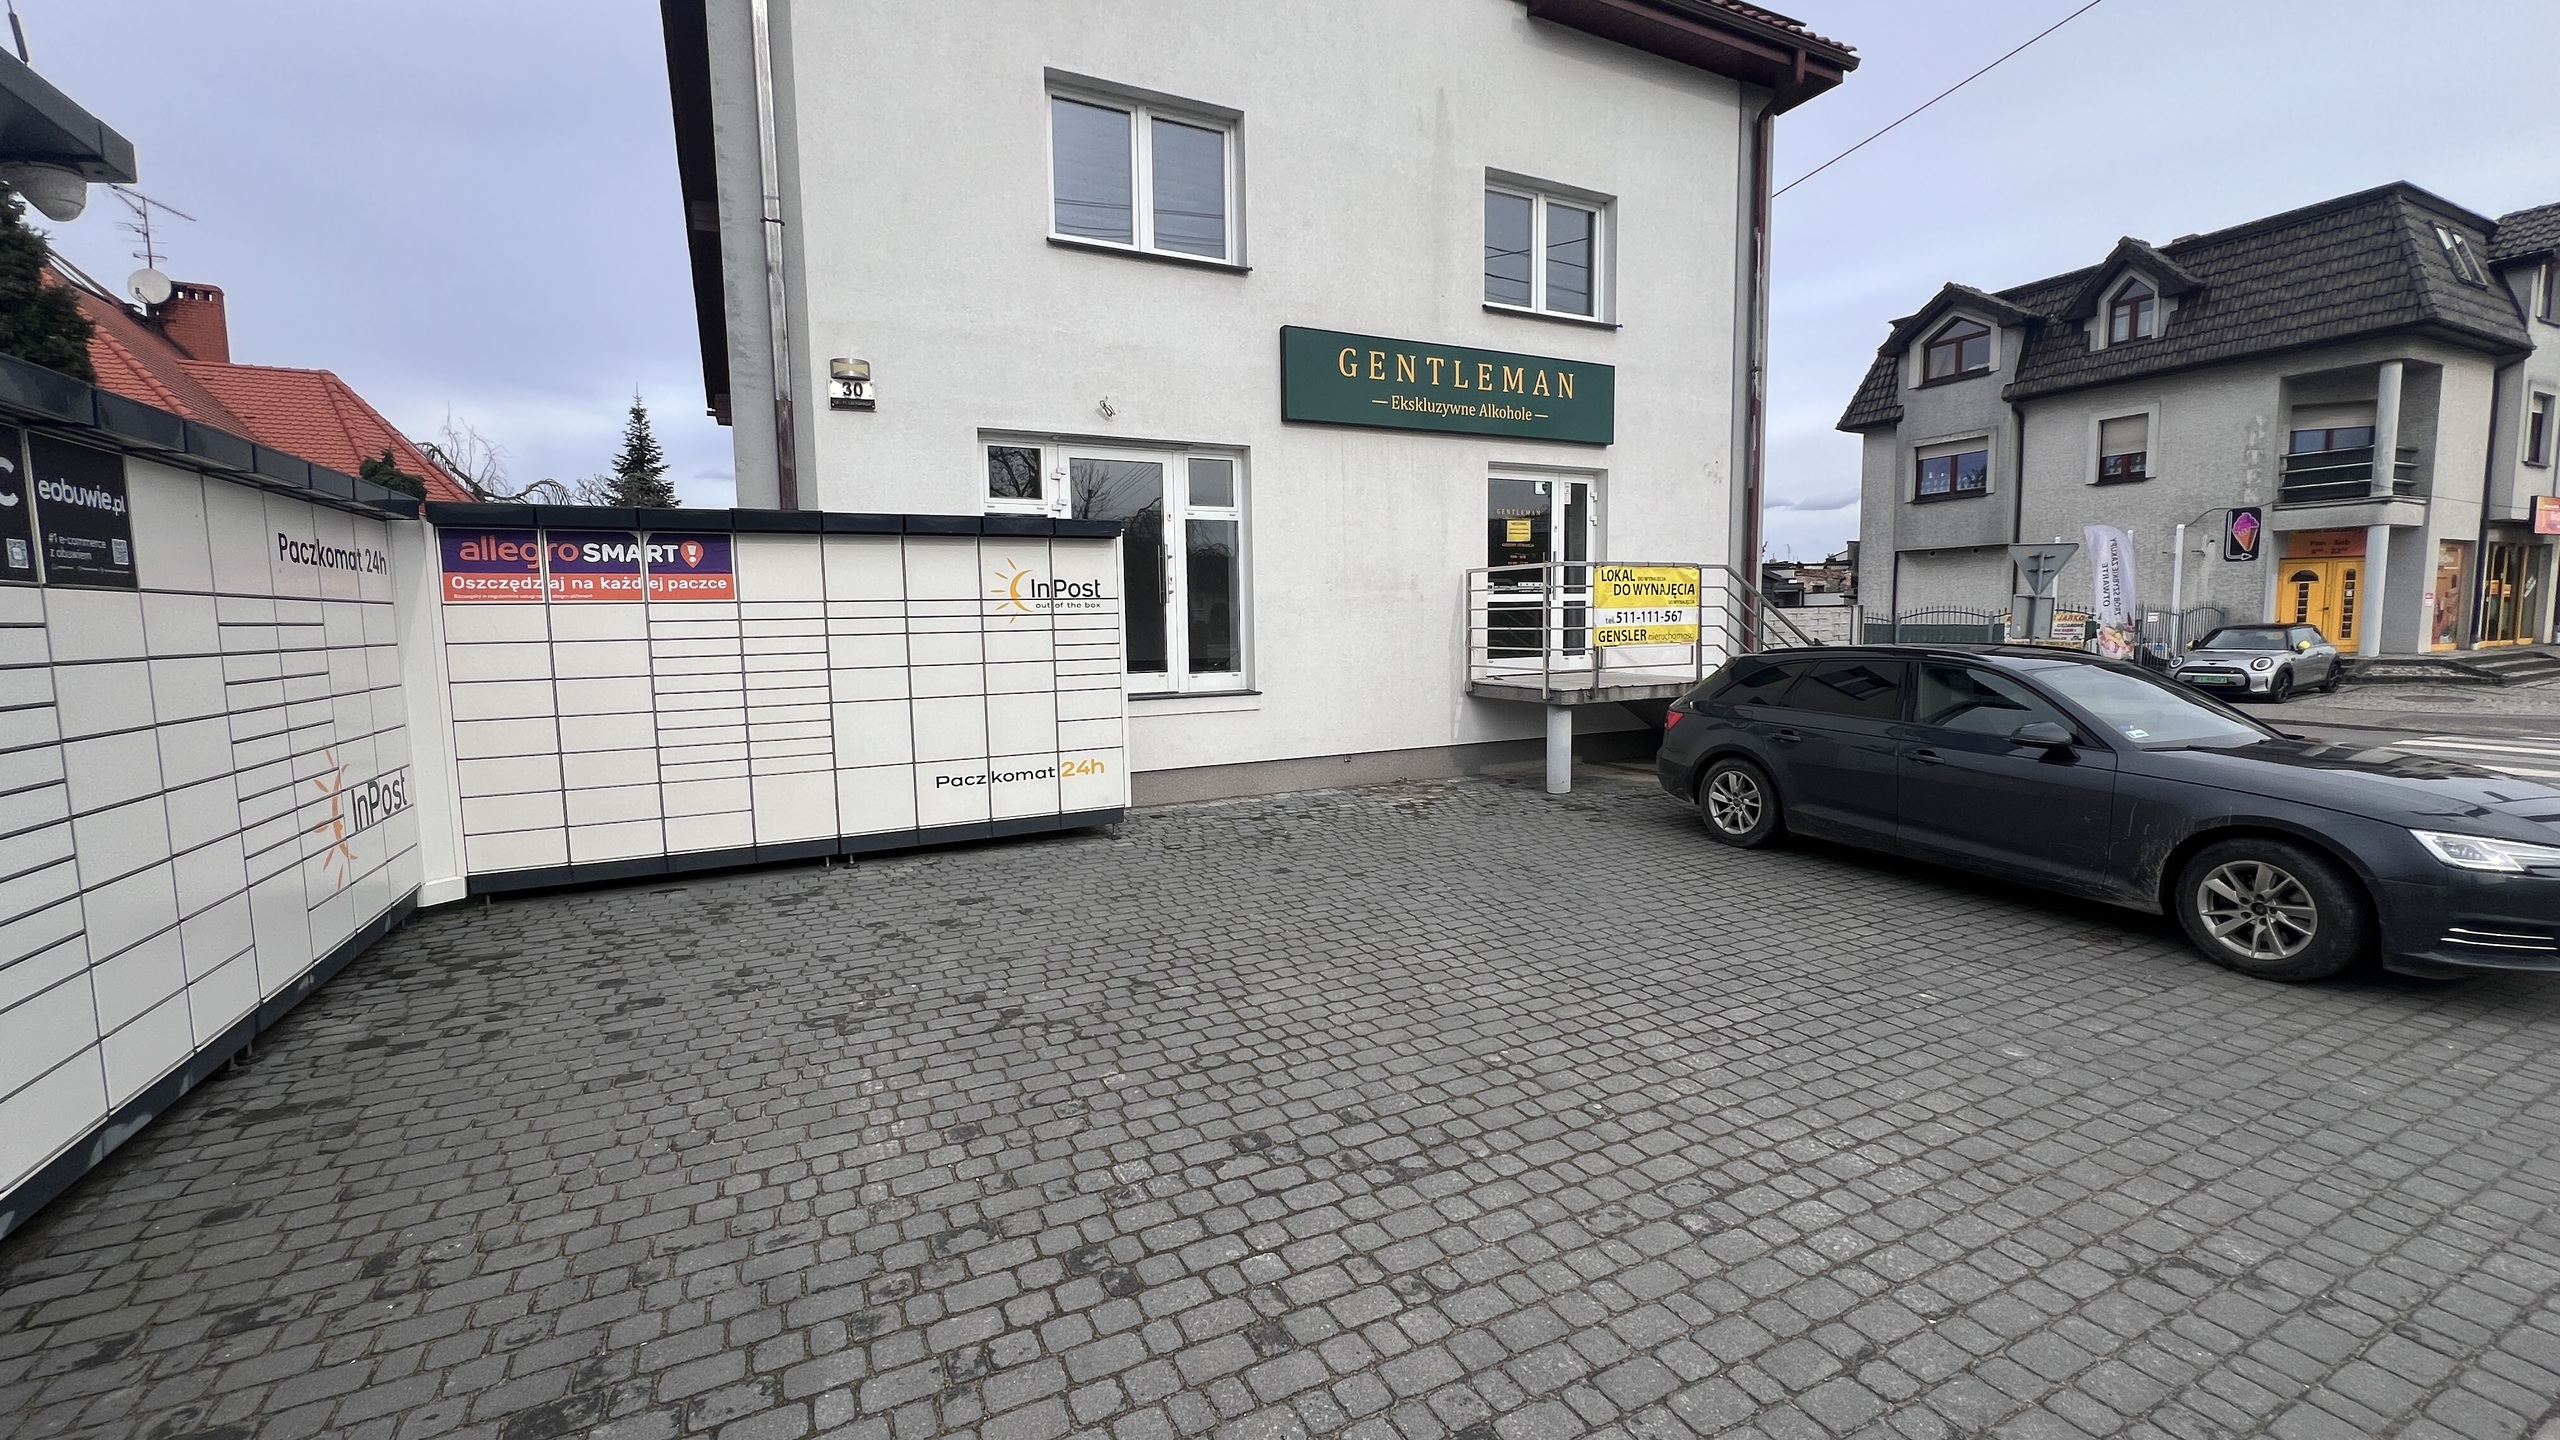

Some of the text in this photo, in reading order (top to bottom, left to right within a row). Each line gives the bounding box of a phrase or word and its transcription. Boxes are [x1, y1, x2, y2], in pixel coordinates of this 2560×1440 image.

[1338, 347, 1575, 400] GENTLEMAN
[842, 381, 863, 397] 30
[1391, 395, 1532, 421] Ekskluzywne Alkohole
[38, 477, 126, 516] eobuwie.pl
[1496, 508, 1541, 516] GENTLEMAN
[278, 532, 387, 575] Paczkomat 24h
[459, 534, 579, 569] allegro
[451, 576, 727, 592] Oszczędzaj na każdej paczce
[1601, 569, 1636, 582] LOKAL
[1031, 578, 1101, 598] InPost
[1613, 583, 1695, 599] DO WYNAJĘCIA
[1598, 629, 1647, 643] GENSLER
[935, 758, 1105, 789] Paczkomat 24h
[351, 768, 408, 832] InPost
